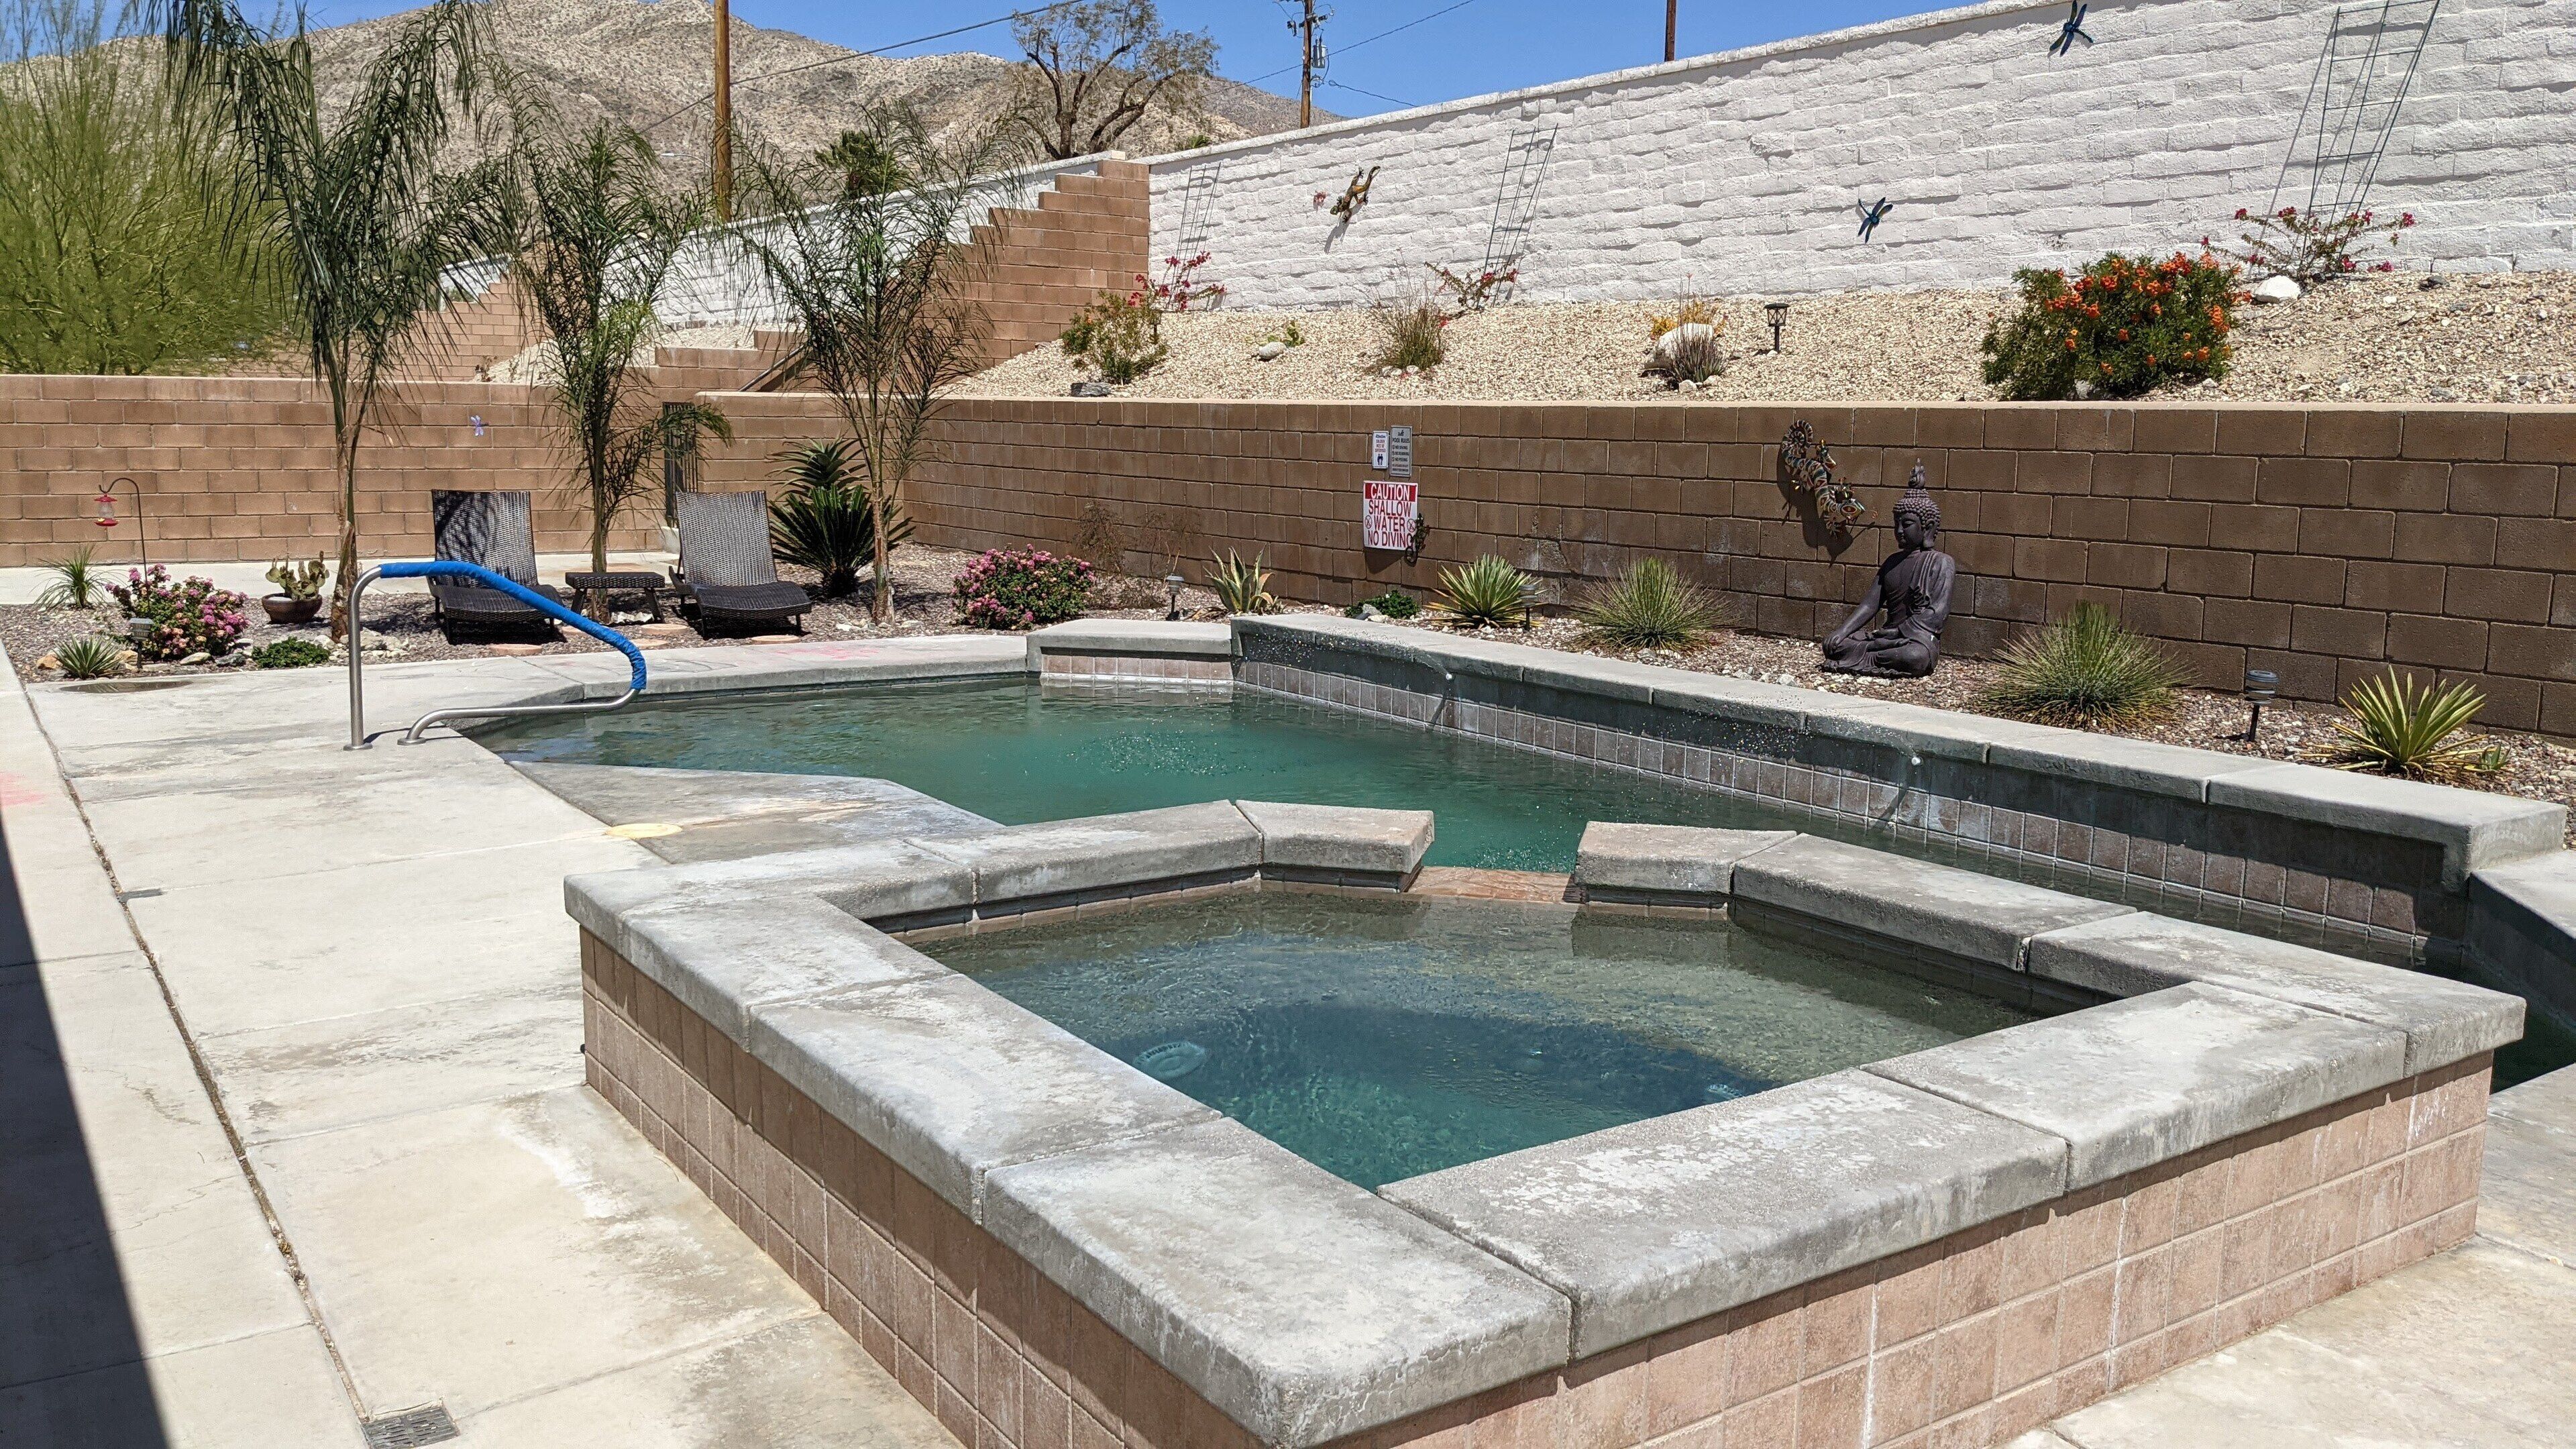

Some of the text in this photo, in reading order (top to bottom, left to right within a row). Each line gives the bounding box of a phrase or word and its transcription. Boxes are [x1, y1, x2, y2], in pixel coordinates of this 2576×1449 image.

[1371, 483, 1409, 501] CAUTION
[1368, 500, 1411, 517] SHALLOW
[1374, 515, 1405, 533] WATER
[1368, 530, 1413, 547] NO DIVING
